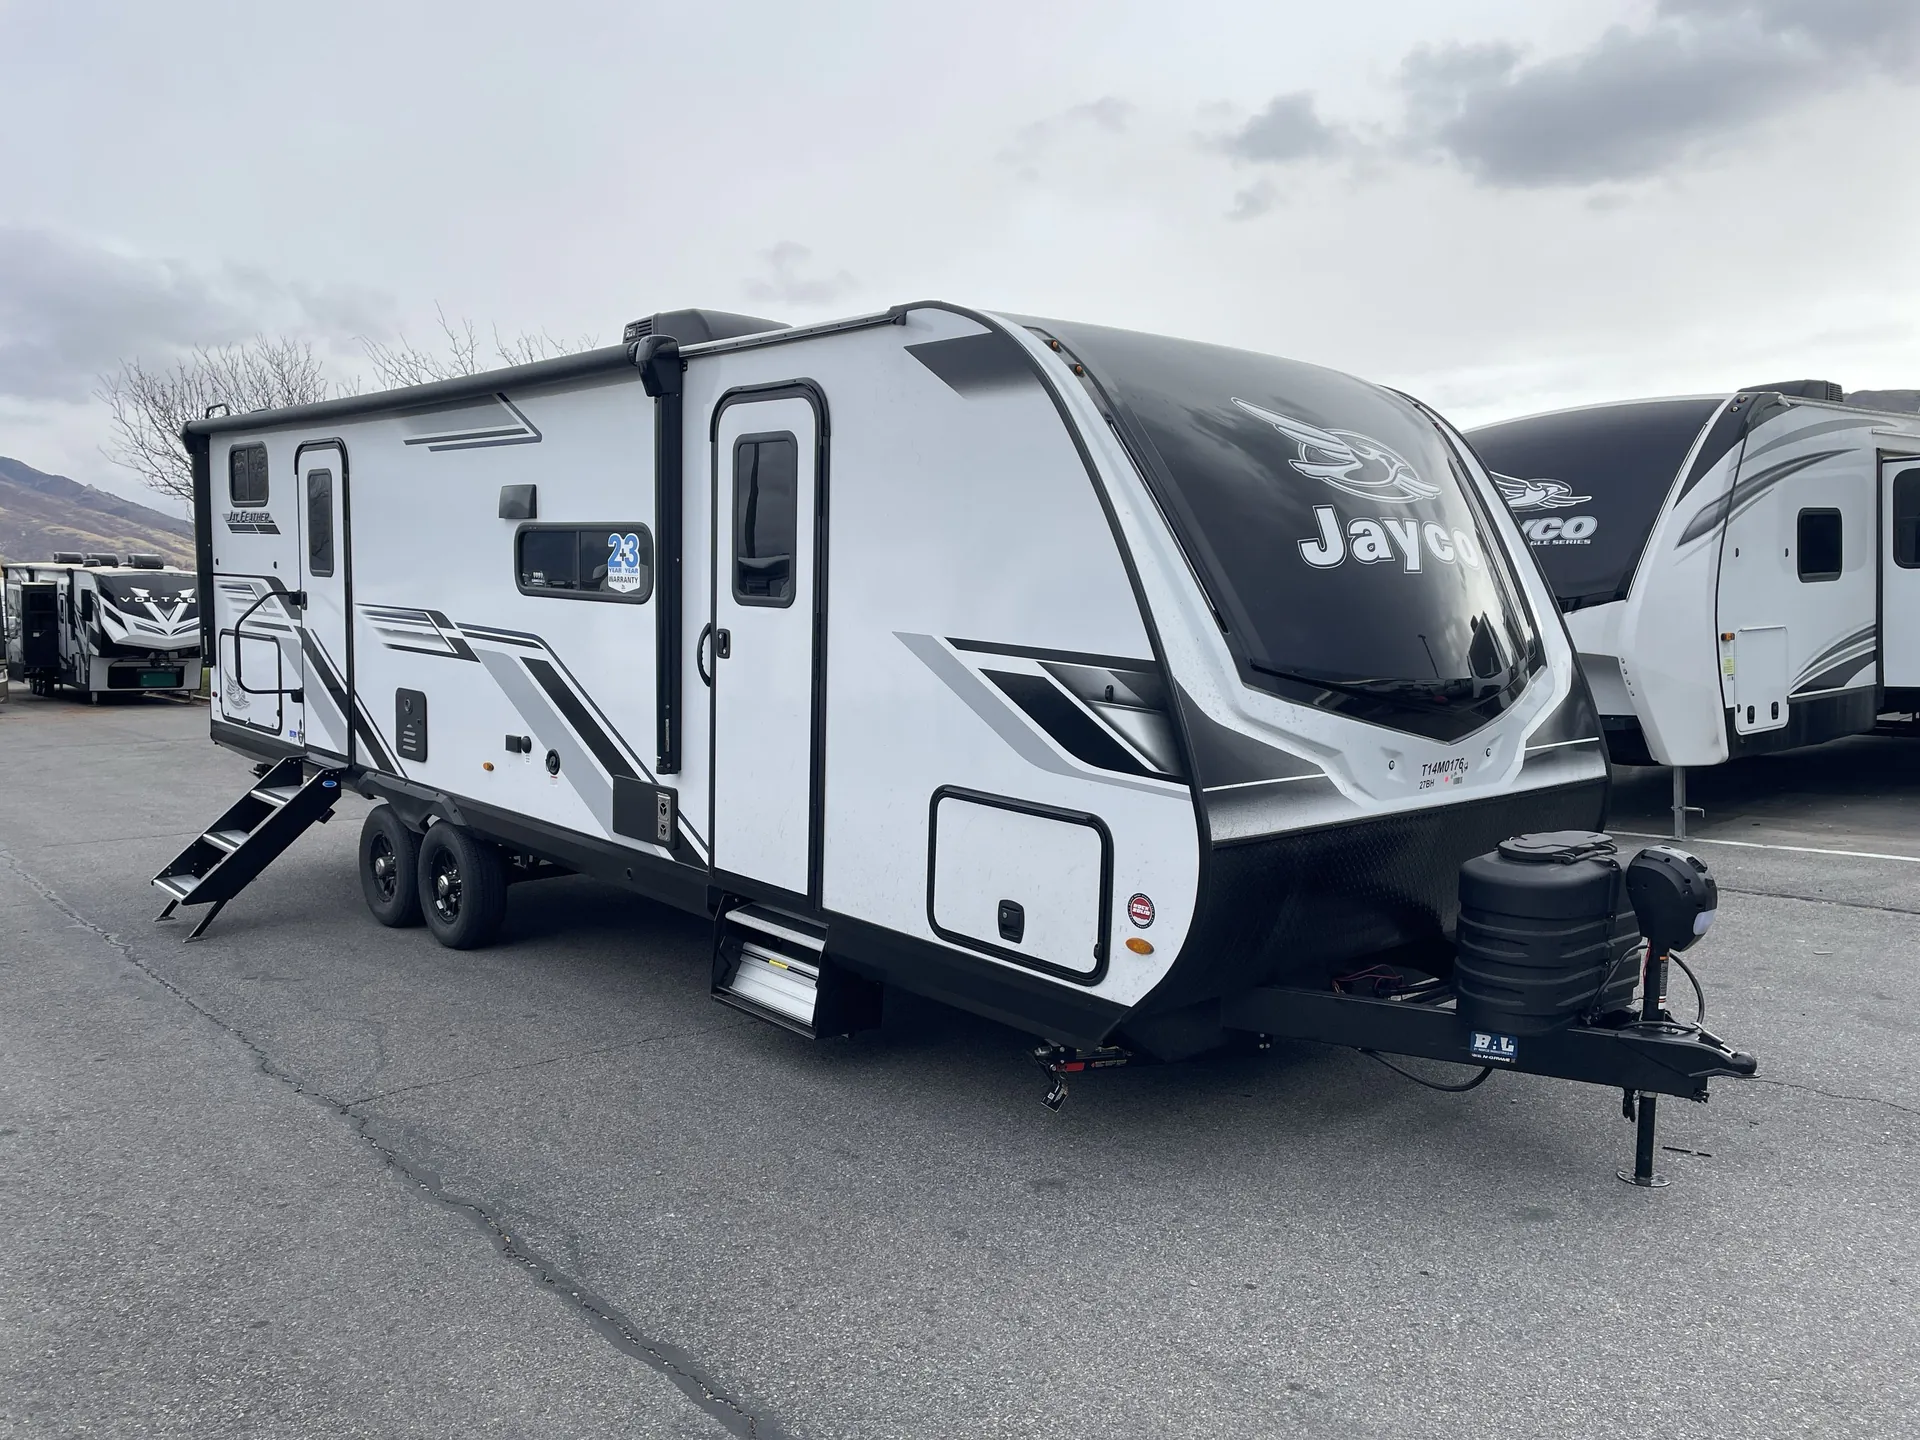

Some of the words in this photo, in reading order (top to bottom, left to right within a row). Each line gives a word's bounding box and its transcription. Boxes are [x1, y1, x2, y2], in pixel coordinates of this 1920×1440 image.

[1297, 505, 1479, 573] Jayco
[608, 576, 639, 584] WARRANTY
[120, 596, 196, 604] VOLTAG
[1419, 778, 1435, 790] 27BH
